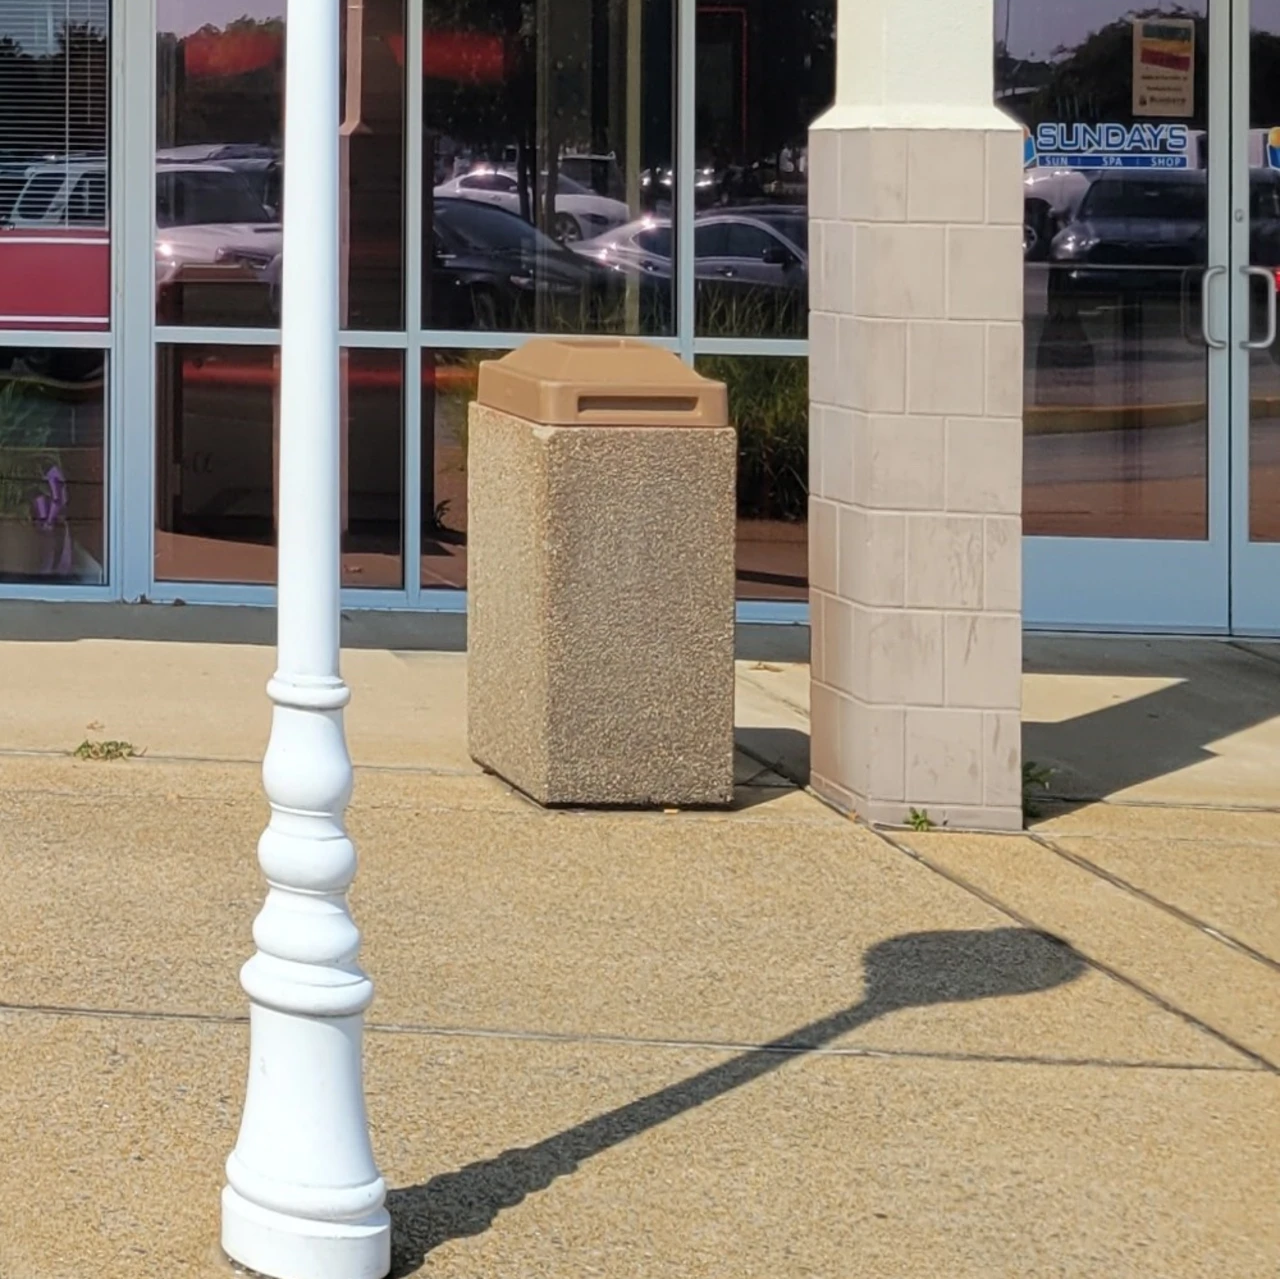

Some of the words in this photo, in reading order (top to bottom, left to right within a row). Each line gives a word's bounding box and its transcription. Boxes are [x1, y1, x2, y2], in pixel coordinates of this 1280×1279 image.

[1037, 123, 1188, 151] SUNDAYS
[1045, 157, 1068, 166] SUN
[1102, 156, 1123, 166] SPA
[1150, 157, 1181, 167] SHOP
